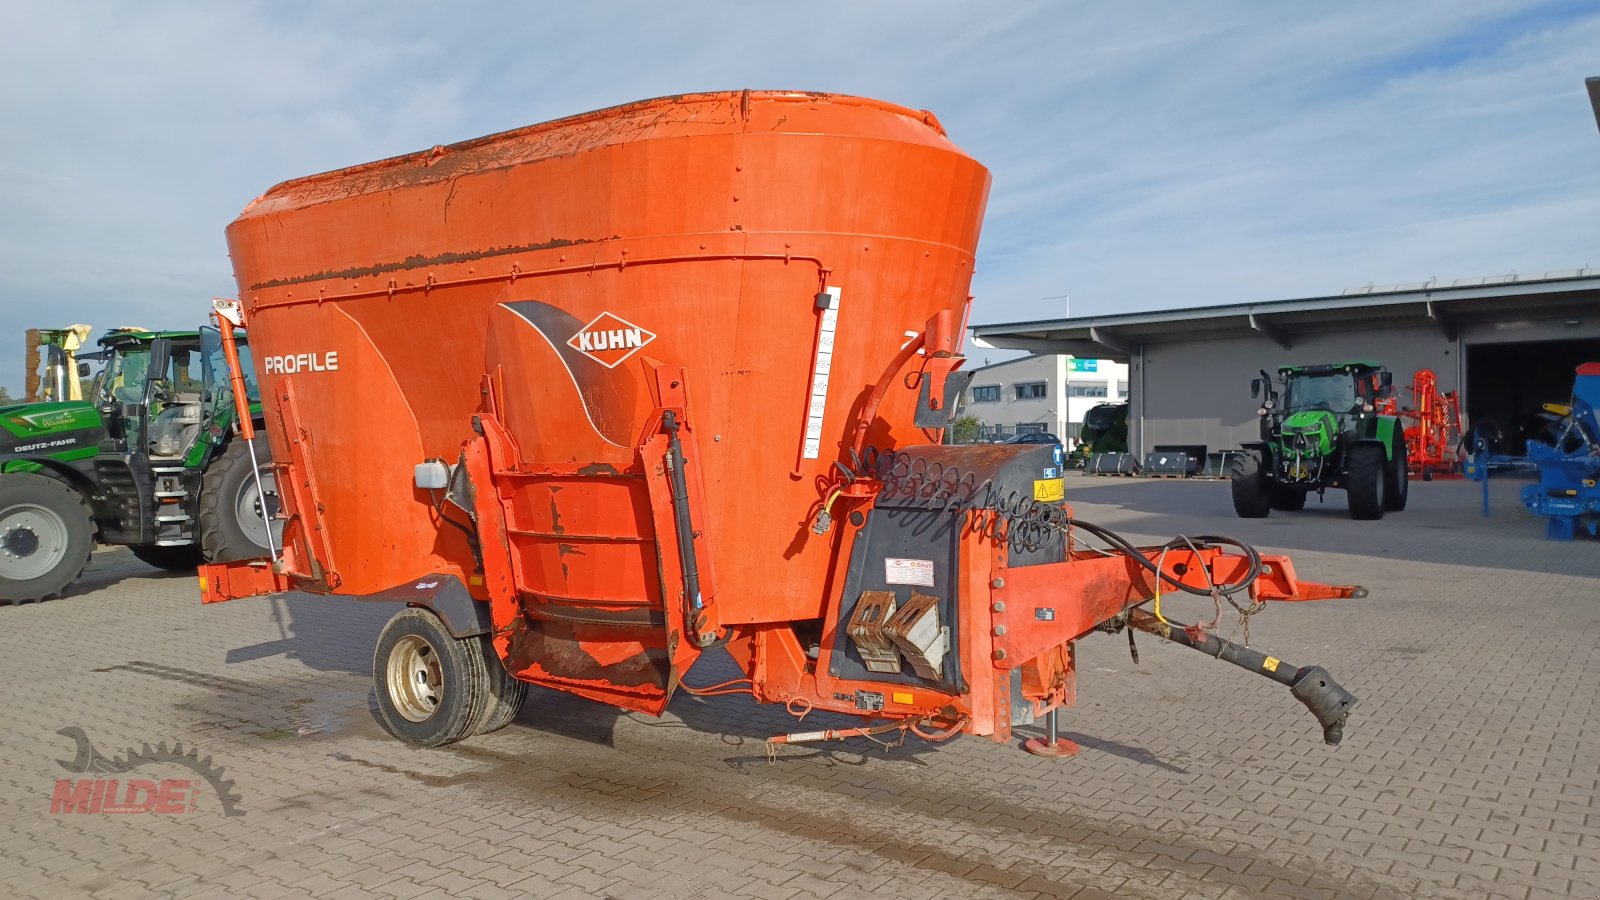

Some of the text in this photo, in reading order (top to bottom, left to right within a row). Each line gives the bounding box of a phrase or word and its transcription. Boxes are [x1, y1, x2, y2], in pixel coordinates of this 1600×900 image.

[579, 328, 642, 351] KUHN
[264, 350, 339, 375] PROFILE
[14, 438, 76, 452] DEUTZ-FAHR
